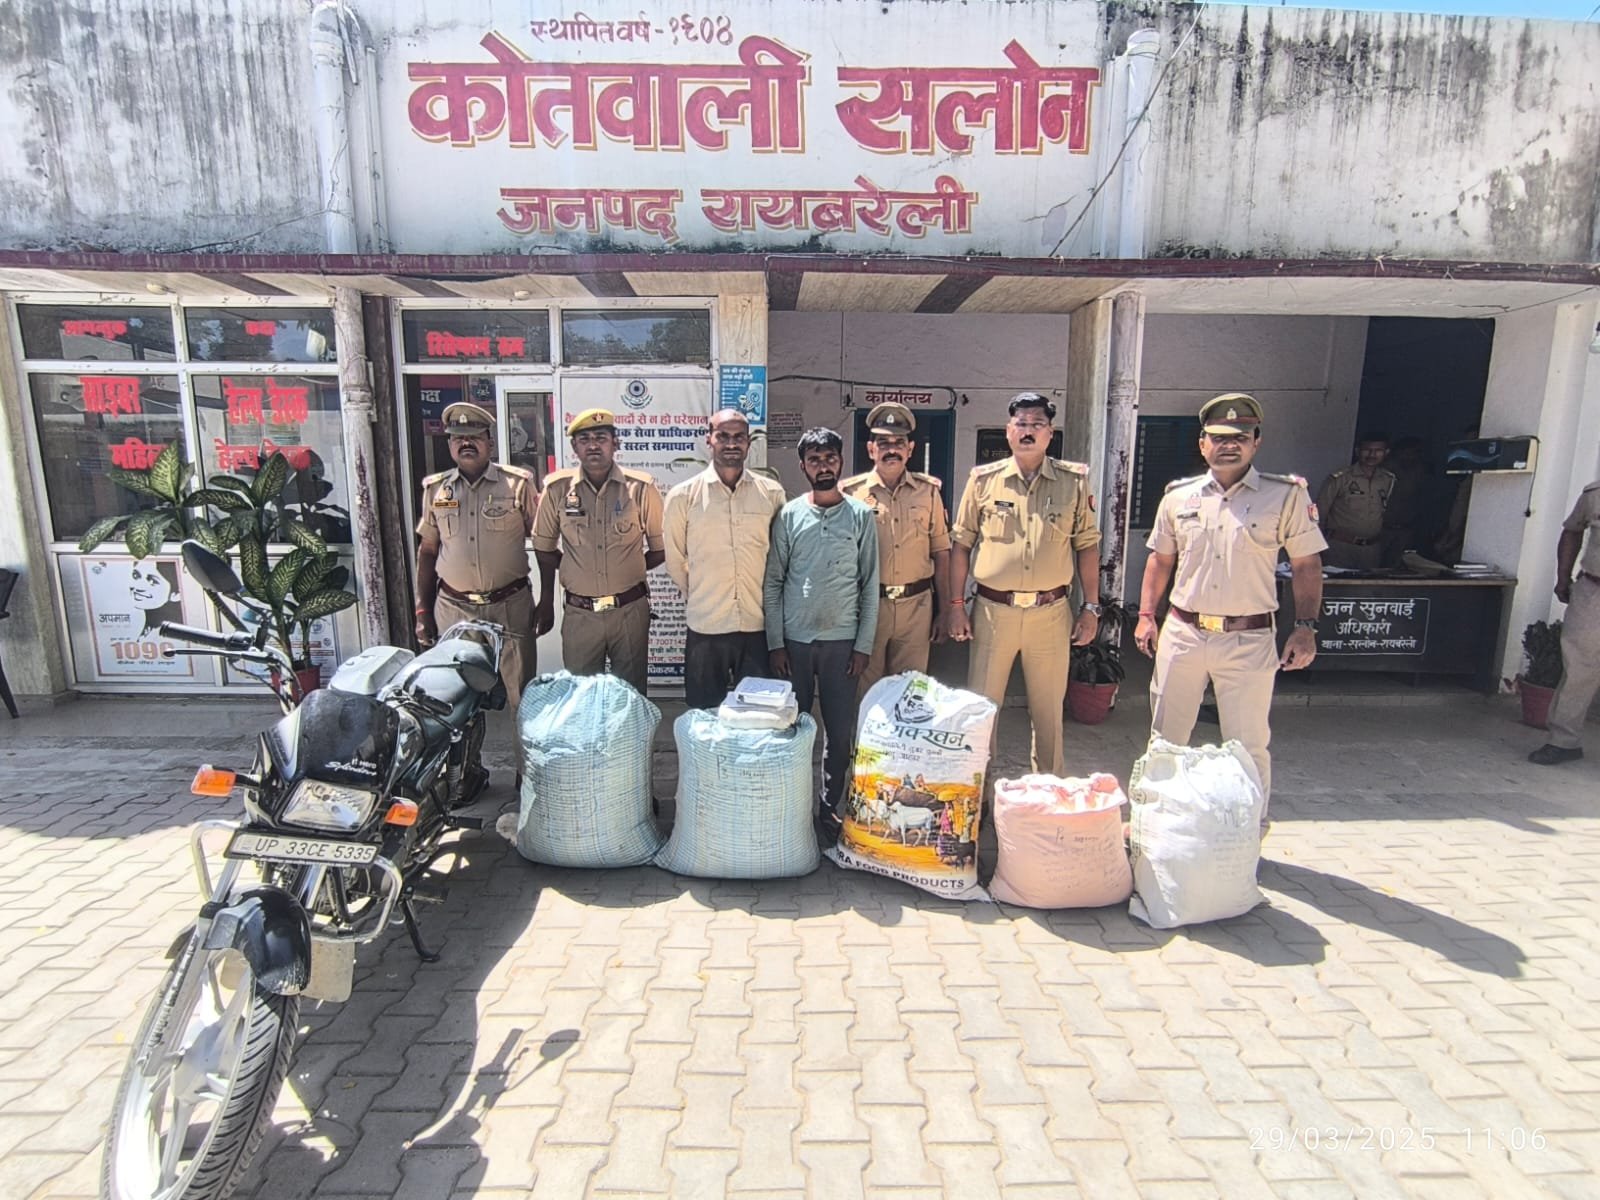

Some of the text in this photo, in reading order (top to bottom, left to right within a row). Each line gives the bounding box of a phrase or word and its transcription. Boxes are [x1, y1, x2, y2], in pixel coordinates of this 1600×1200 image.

[407, 33, 1101, 154] कोतवाली सलोन
[496, 174, 978, 245] जनपद रायबरेली
[865, 389, 933, 404] कार्यालय
[634, 426, 656, 438] सेवा
[623, 442, 650, 451] सरल
[1323, 599, 1416, 620] जन सुनवाई
[1335, 619, 1392, 635] अधिकारी
[255, 838, 374, 861] UP 33CE 5335
[892, 871, 965, 888] PRODUCTS
